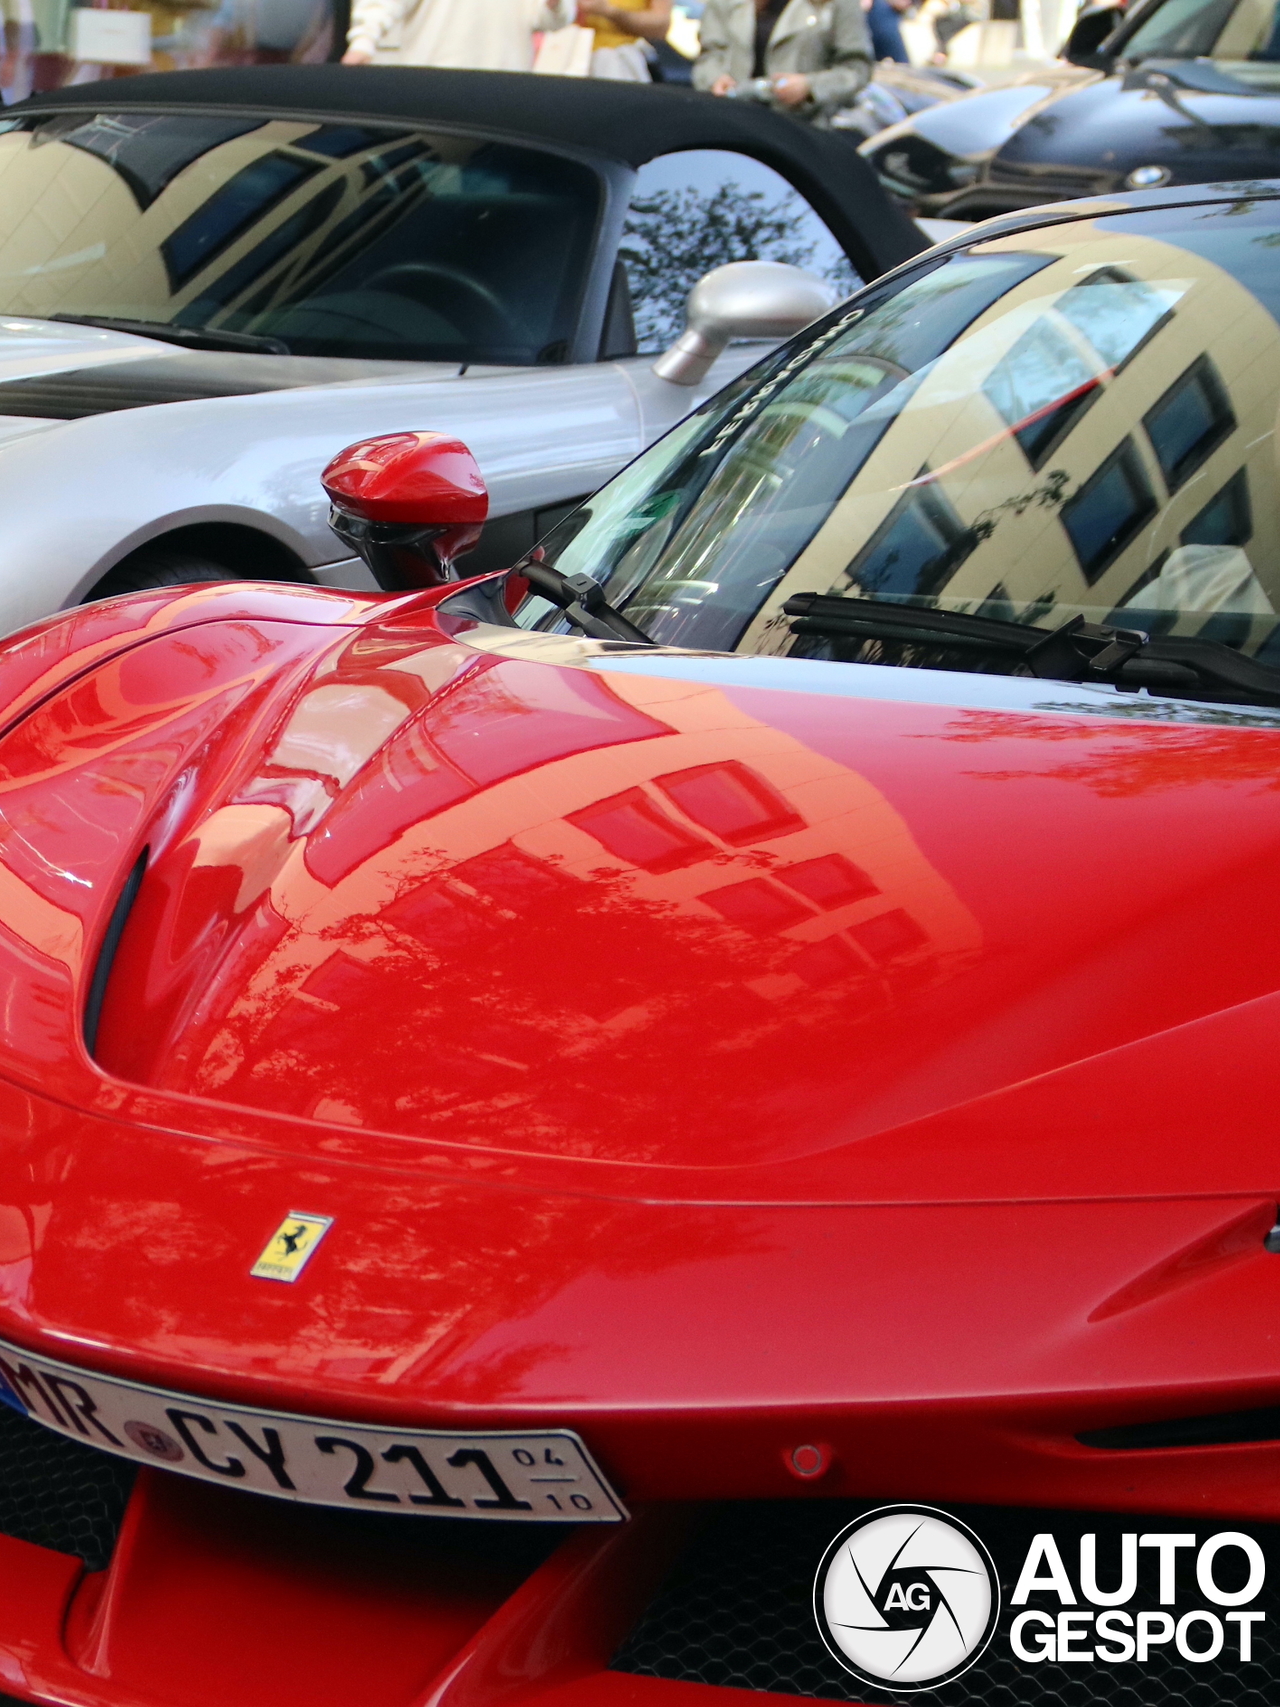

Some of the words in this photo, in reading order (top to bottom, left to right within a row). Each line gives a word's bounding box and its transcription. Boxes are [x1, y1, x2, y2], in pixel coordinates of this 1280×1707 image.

[166, 1408, 297, 1491] CY
[315, 1436, 533, 1511] 211
[512, 1448, 565, 1467] 04
[546, 1494, 593, 1511] 10
